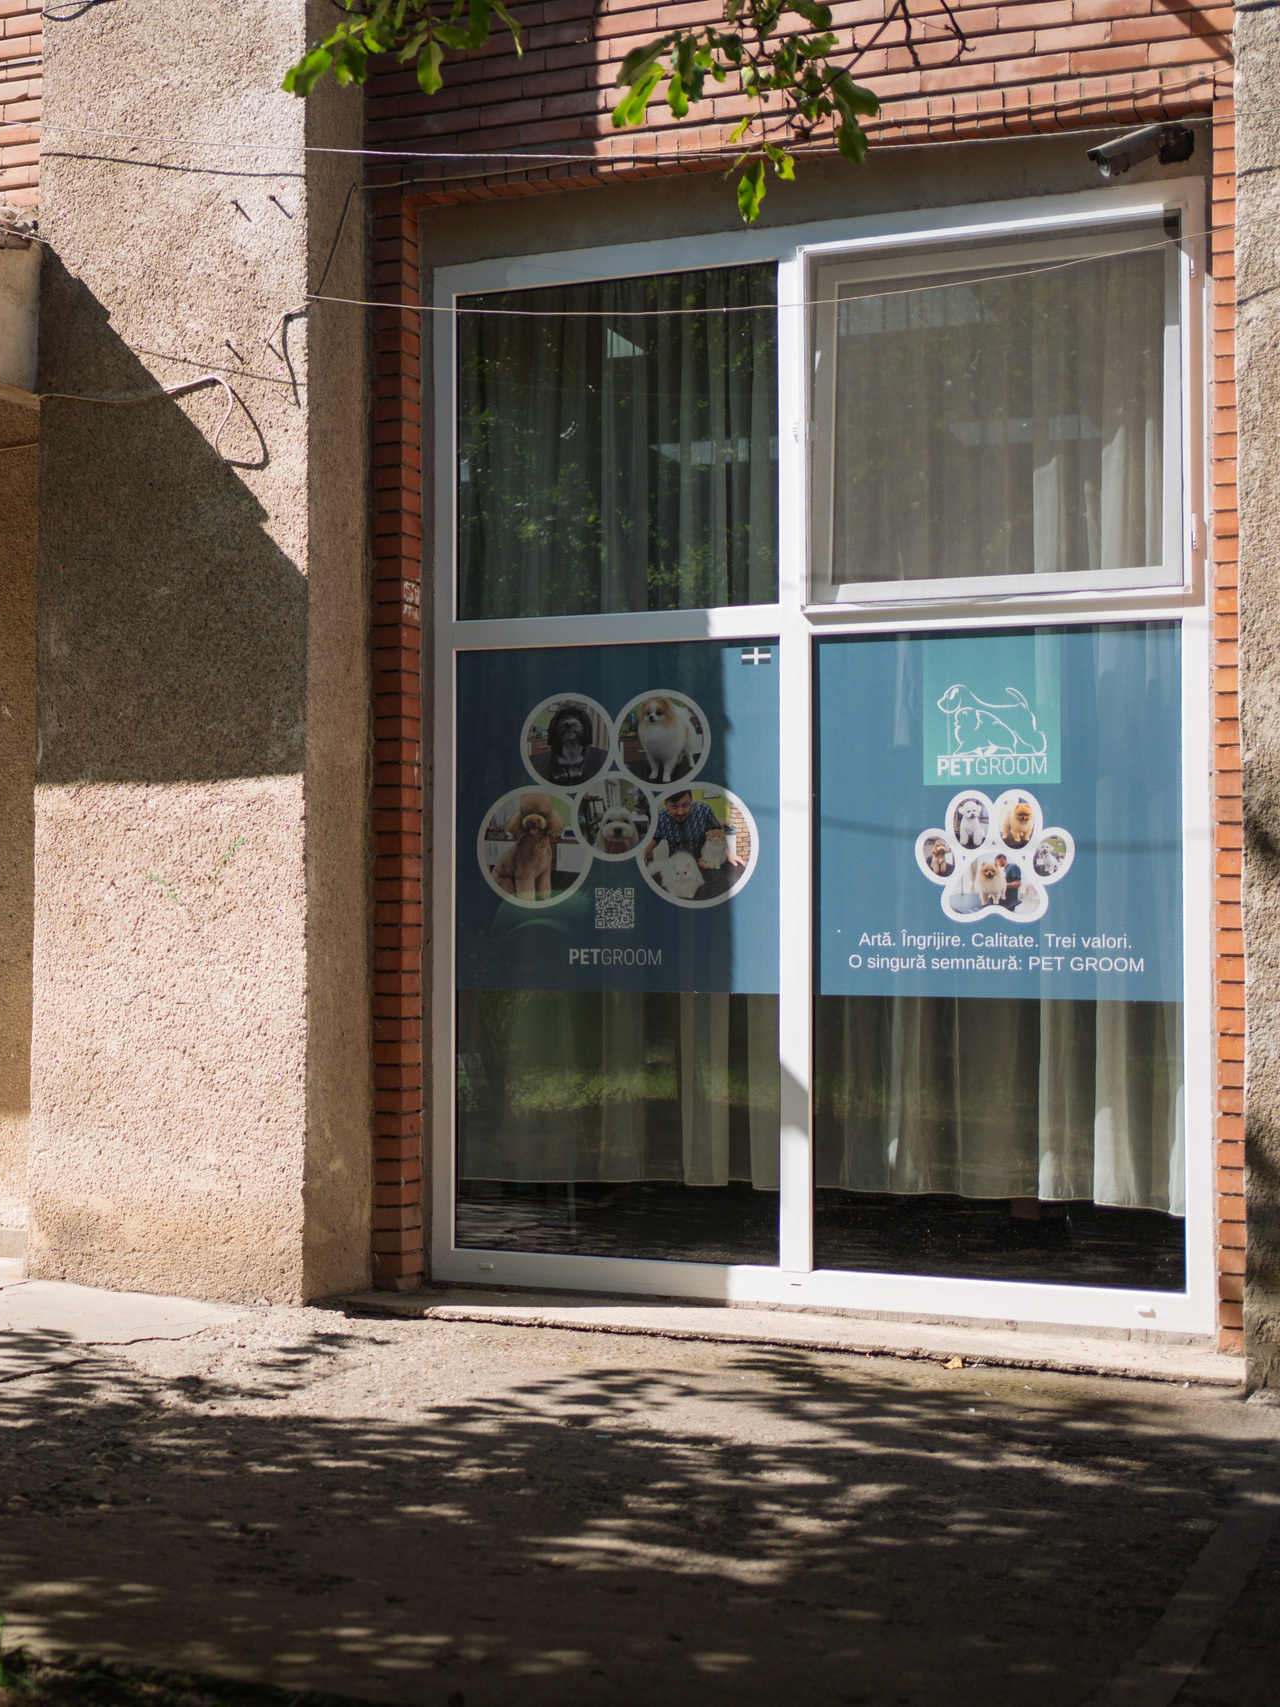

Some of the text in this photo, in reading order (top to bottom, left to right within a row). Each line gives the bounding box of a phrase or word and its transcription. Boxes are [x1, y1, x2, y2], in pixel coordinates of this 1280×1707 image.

[937, 756, 1048, 776] PETGROOM
[858, 929, 1132, 950] Artă. Îngrijire. Calitate. Trei valori.
[568, 948, 662, 966] PETGROOM
[848, 954, 1145, 972] O singură semnătură: PET GROOM
